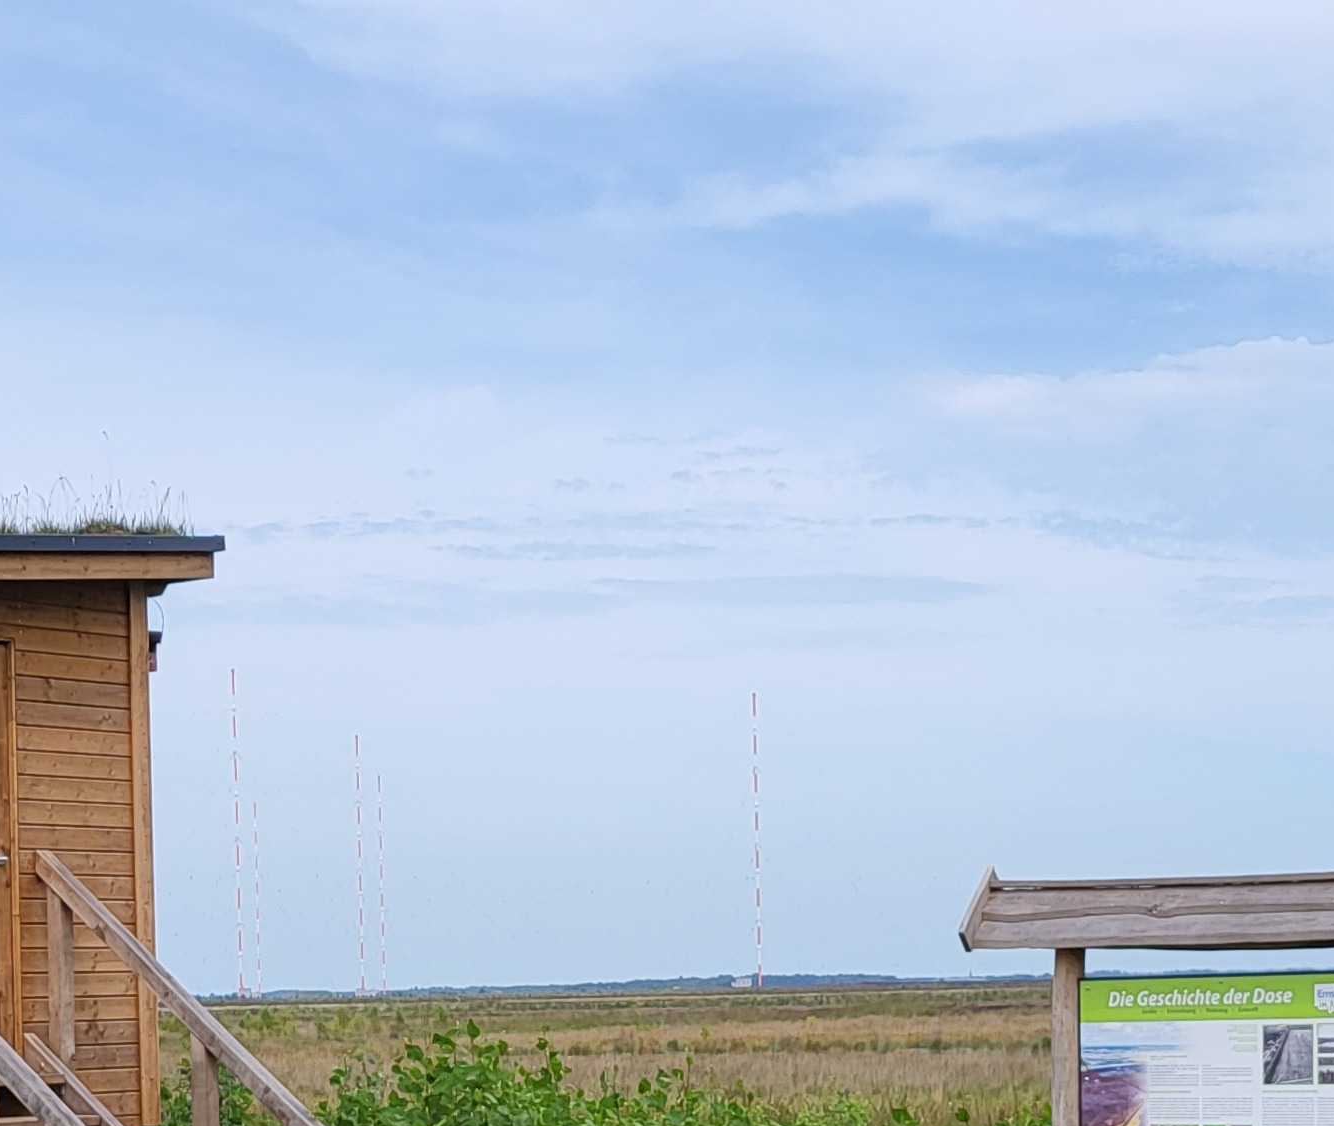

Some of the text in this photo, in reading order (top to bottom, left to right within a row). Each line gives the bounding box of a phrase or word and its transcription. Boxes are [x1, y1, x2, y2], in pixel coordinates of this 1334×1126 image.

[1108, 987, 1293, 1007] Die Geschichte der Dose
[1318, 1000, 1328, 1008] in
